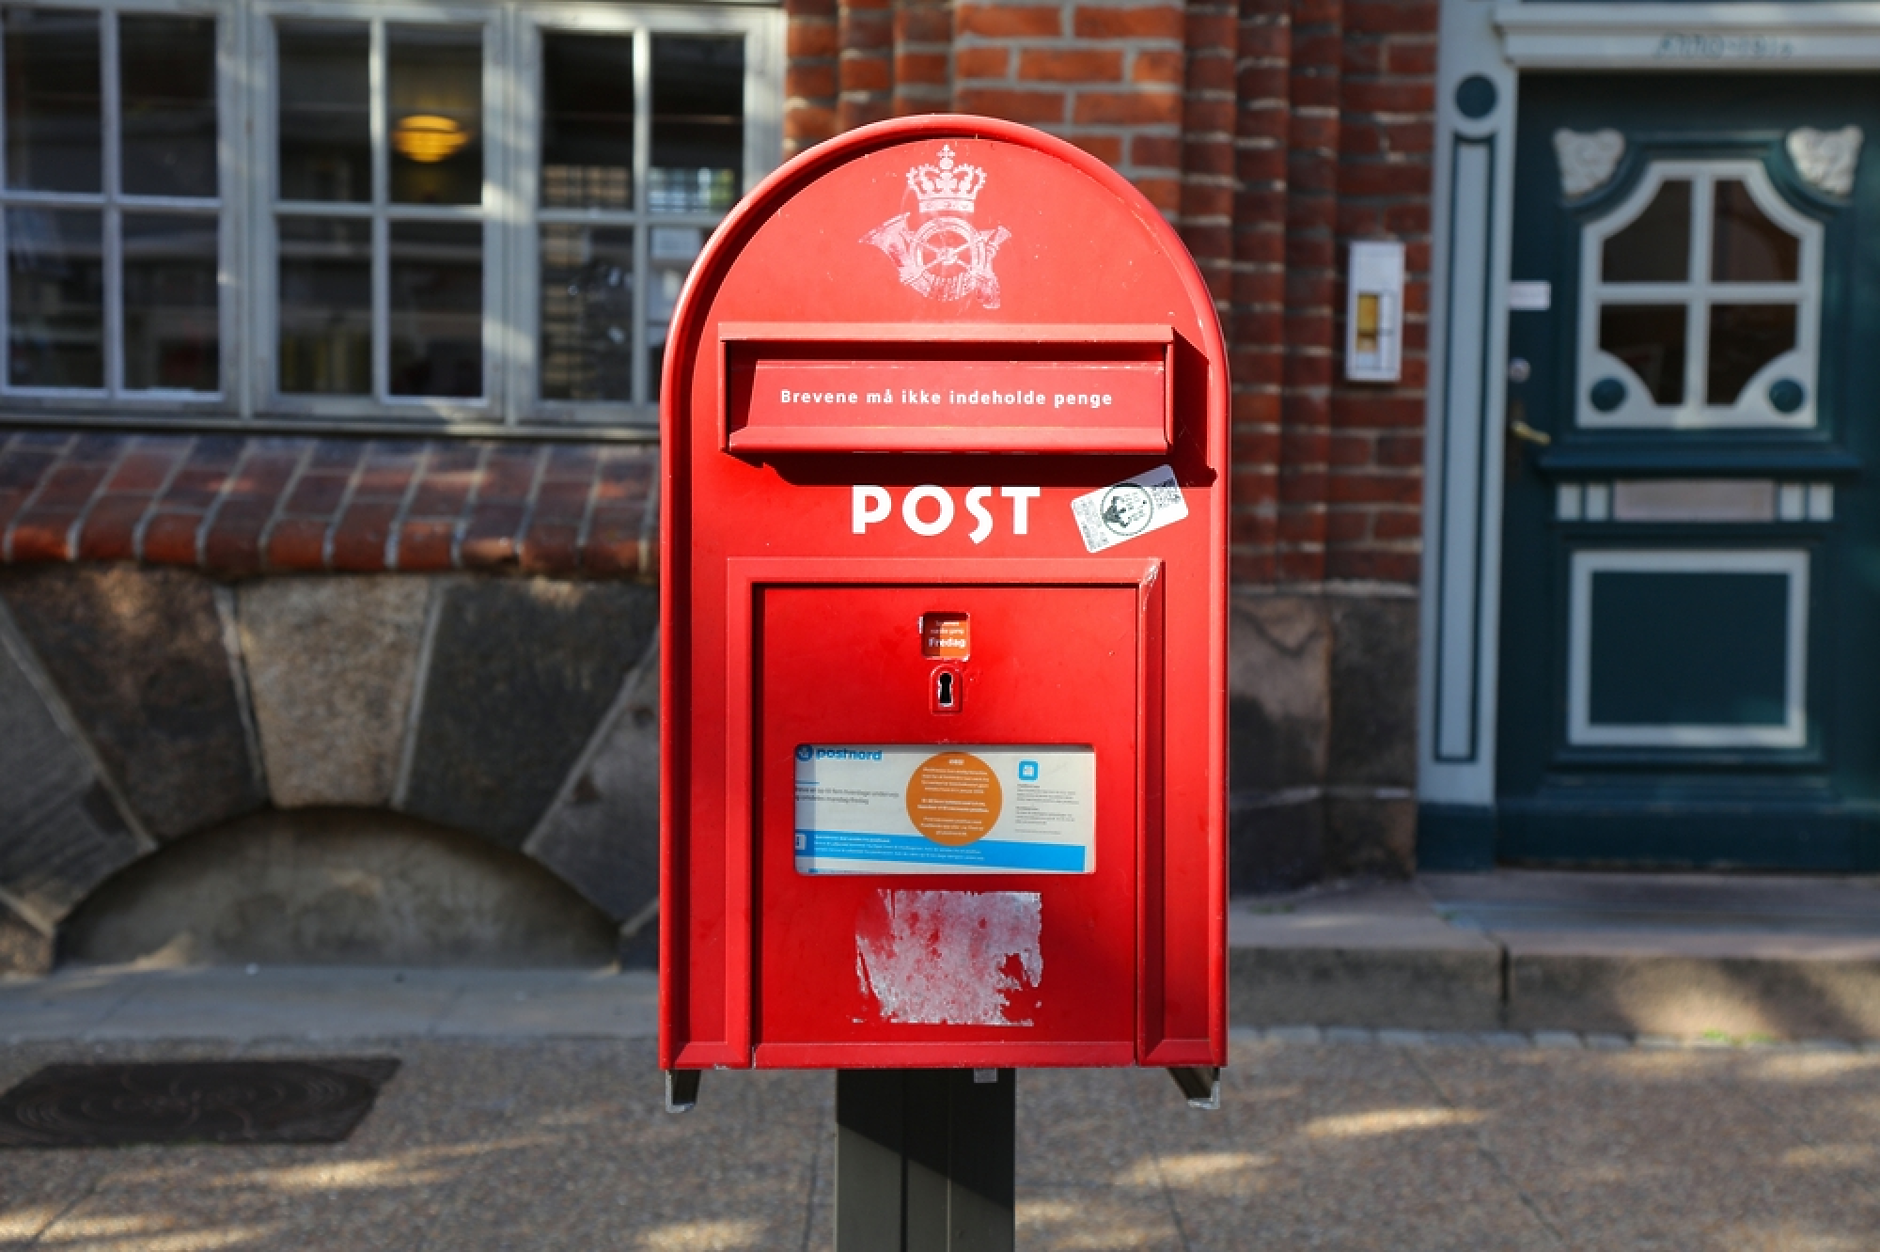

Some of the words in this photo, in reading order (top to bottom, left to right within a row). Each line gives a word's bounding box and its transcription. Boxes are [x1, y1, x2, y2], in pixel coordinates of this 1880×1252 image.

[780, 389, 858, 403] Brevene
[866, 388, 894, 403] må
[901, 389, 941, 403] ikke
[949, 389, 1046, 404] indeholde
[1054, 393, 1112, 409] penge
[852, 484, 1041, 545] POST
[816, 747, 883, 762] postnord
